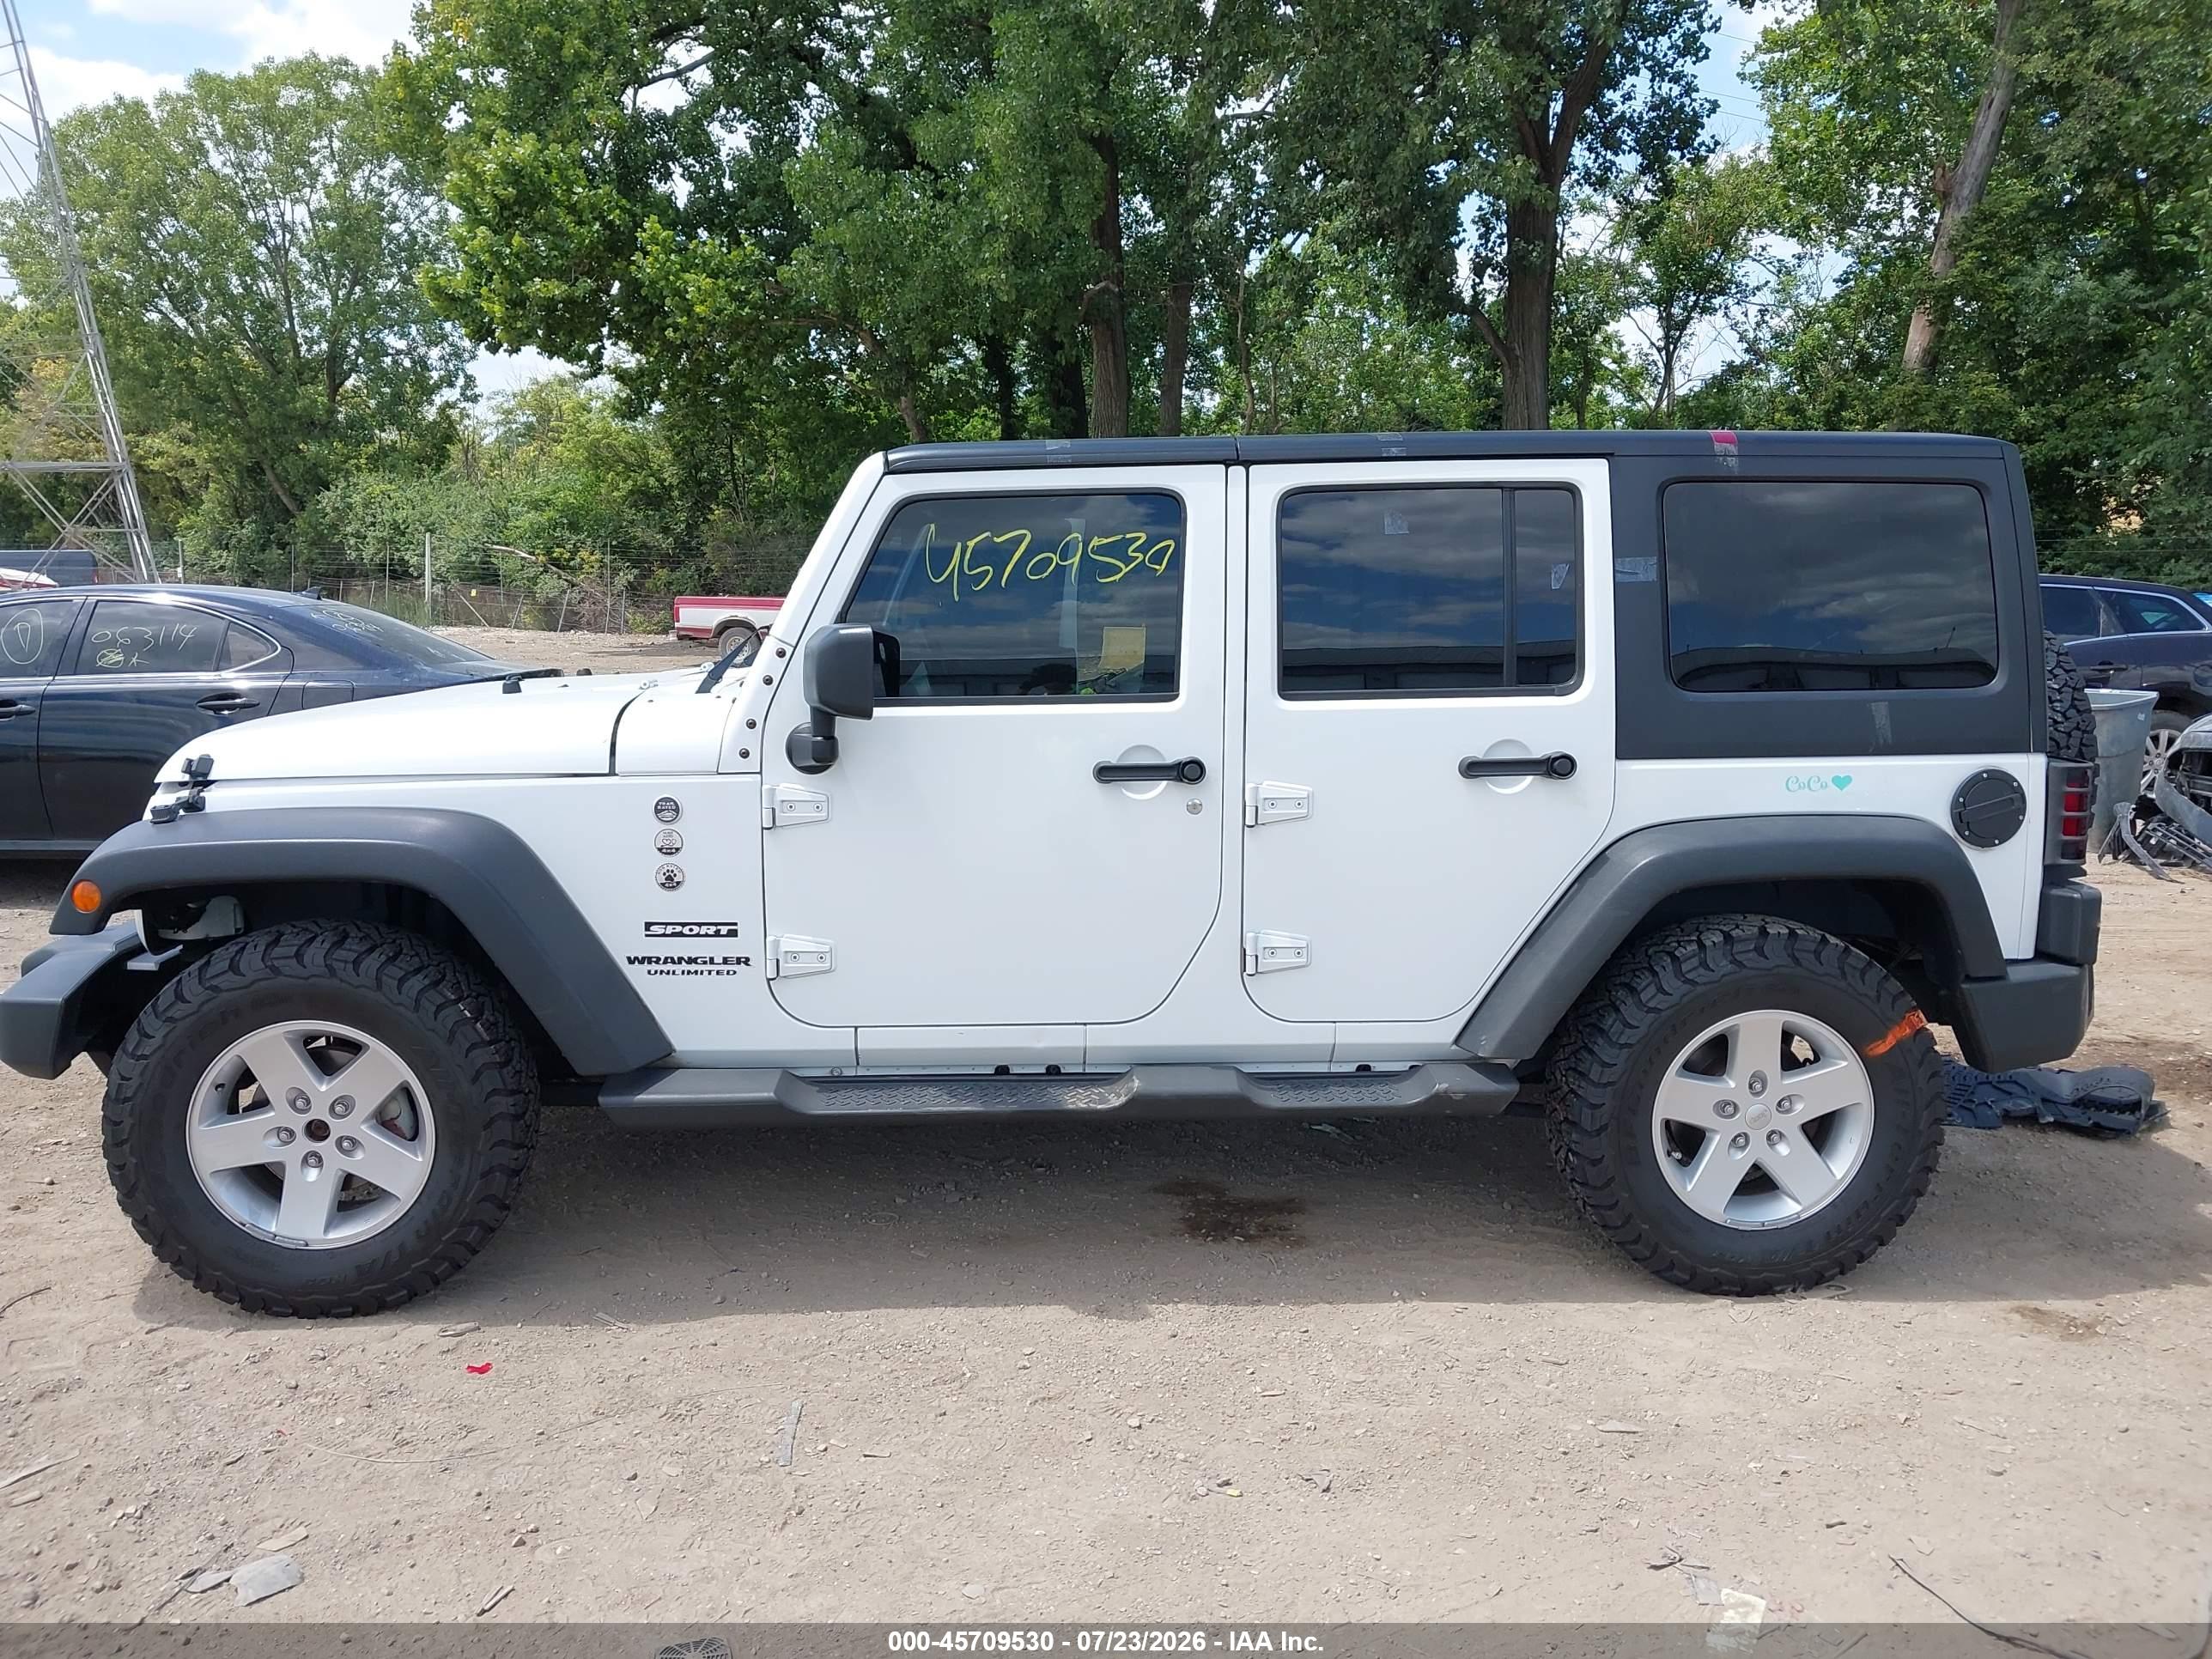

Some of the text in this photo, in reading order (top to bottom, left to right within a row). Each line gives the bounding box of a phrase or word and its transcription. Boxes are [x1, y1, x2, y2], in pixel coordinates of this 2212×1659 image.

[927, 523, 1176, 602] 45709530
[91, 623, 198, 651] 063114
[1785, 775, 1828, 793] CoCo
[645, 924, 738, 935] SPORT
[626, 956, 752, 967] WRANGLER
